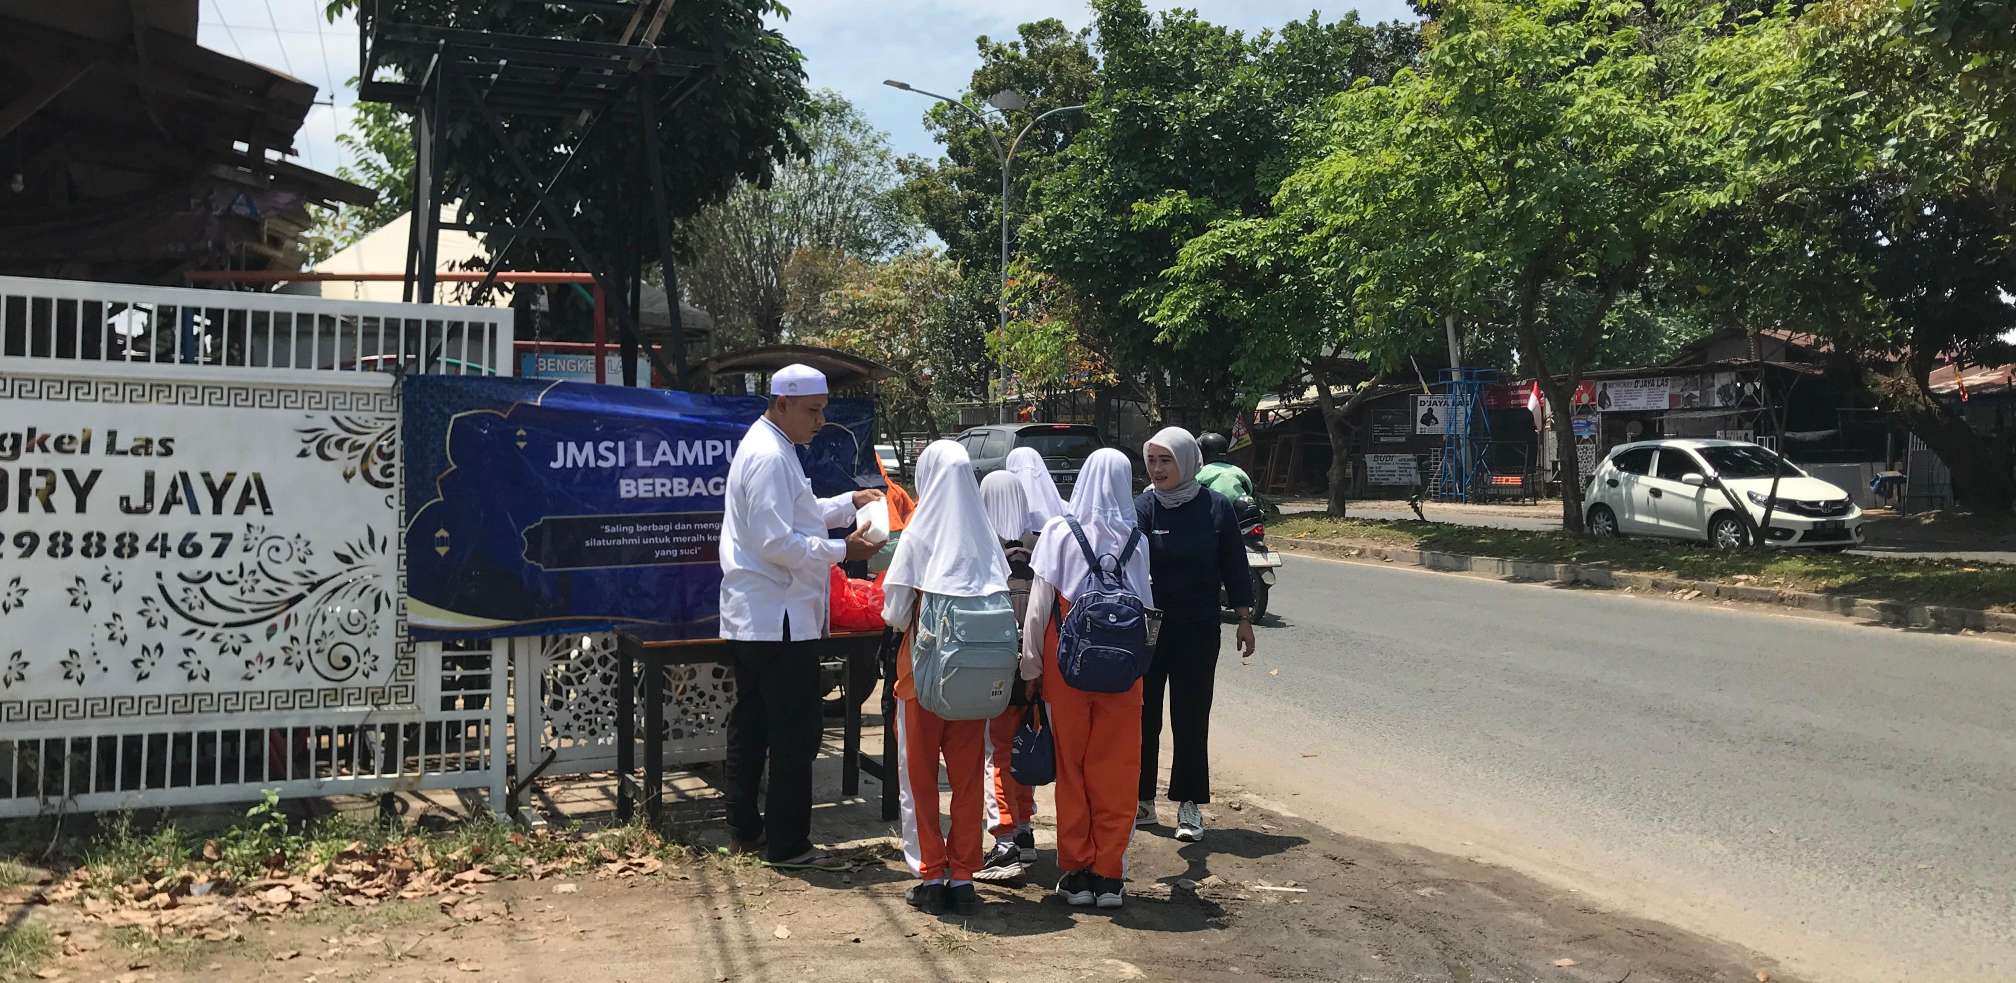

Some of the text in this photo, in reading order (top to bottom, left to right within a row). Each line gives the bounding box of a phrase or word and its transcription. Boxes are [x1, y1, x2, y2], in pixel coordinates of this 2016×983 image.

[537, 358, 596, 373] BENGKE
[105, 429, 175, 458] Las
[550, 440, 740, 469] JMSI LAMPU
[119, 470, 274, 515] JAYA
[619, 477, 727, 499] BERBAG
[636, 521, 673, 533] berbagi
[675, 522, 692, 531] dan
[694, 522, 723, 532] meng
[0, 530, 234, 560] 9888467
[584, 536, 641, 547] silaturahmi
[642, 535, 671, 544] untuk
[673, 533, 705, 543] meraih
[655, 548, 678, 558] yang
